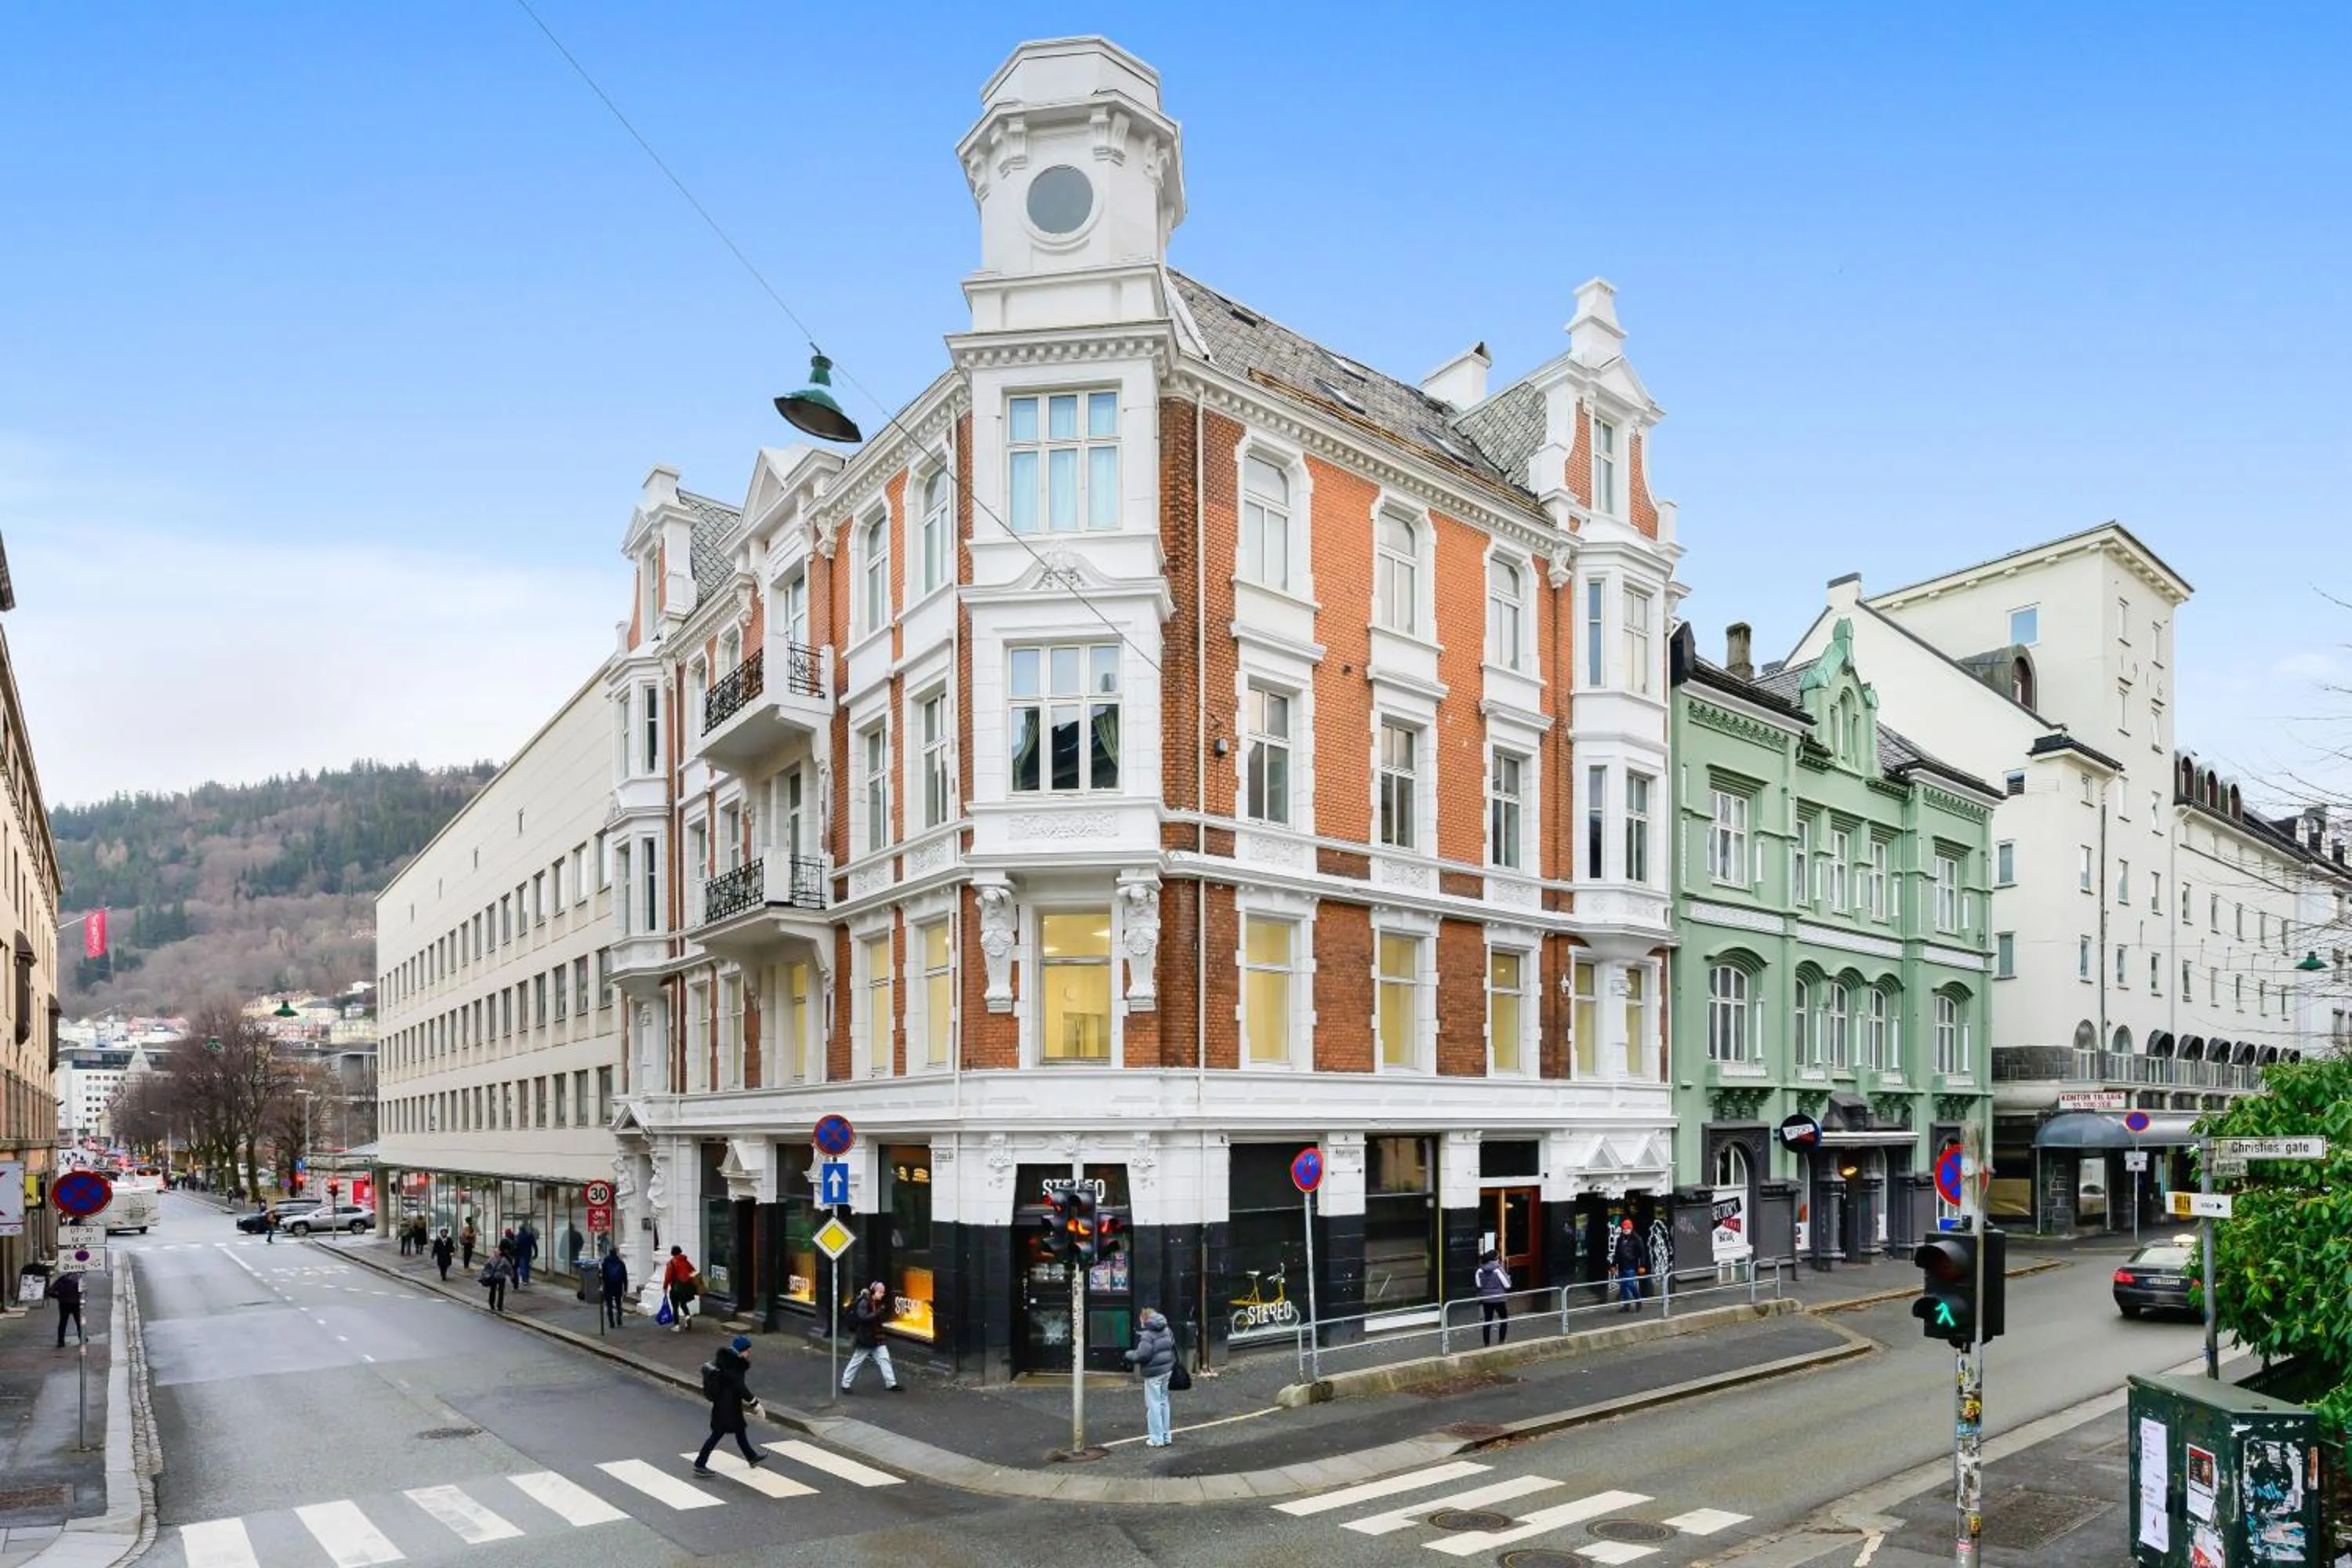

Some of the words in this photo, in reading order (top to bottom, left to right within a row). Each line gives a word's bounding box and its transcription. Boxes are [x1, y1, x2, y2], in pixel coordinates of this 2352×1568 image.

[2231, 1141, 2280, 1153] Christies
[2285, 1142, 2310, 1155] gate
[590, 1188, 608, 1200] 30
[1247, 1301, 1292, 1325] STEREO
